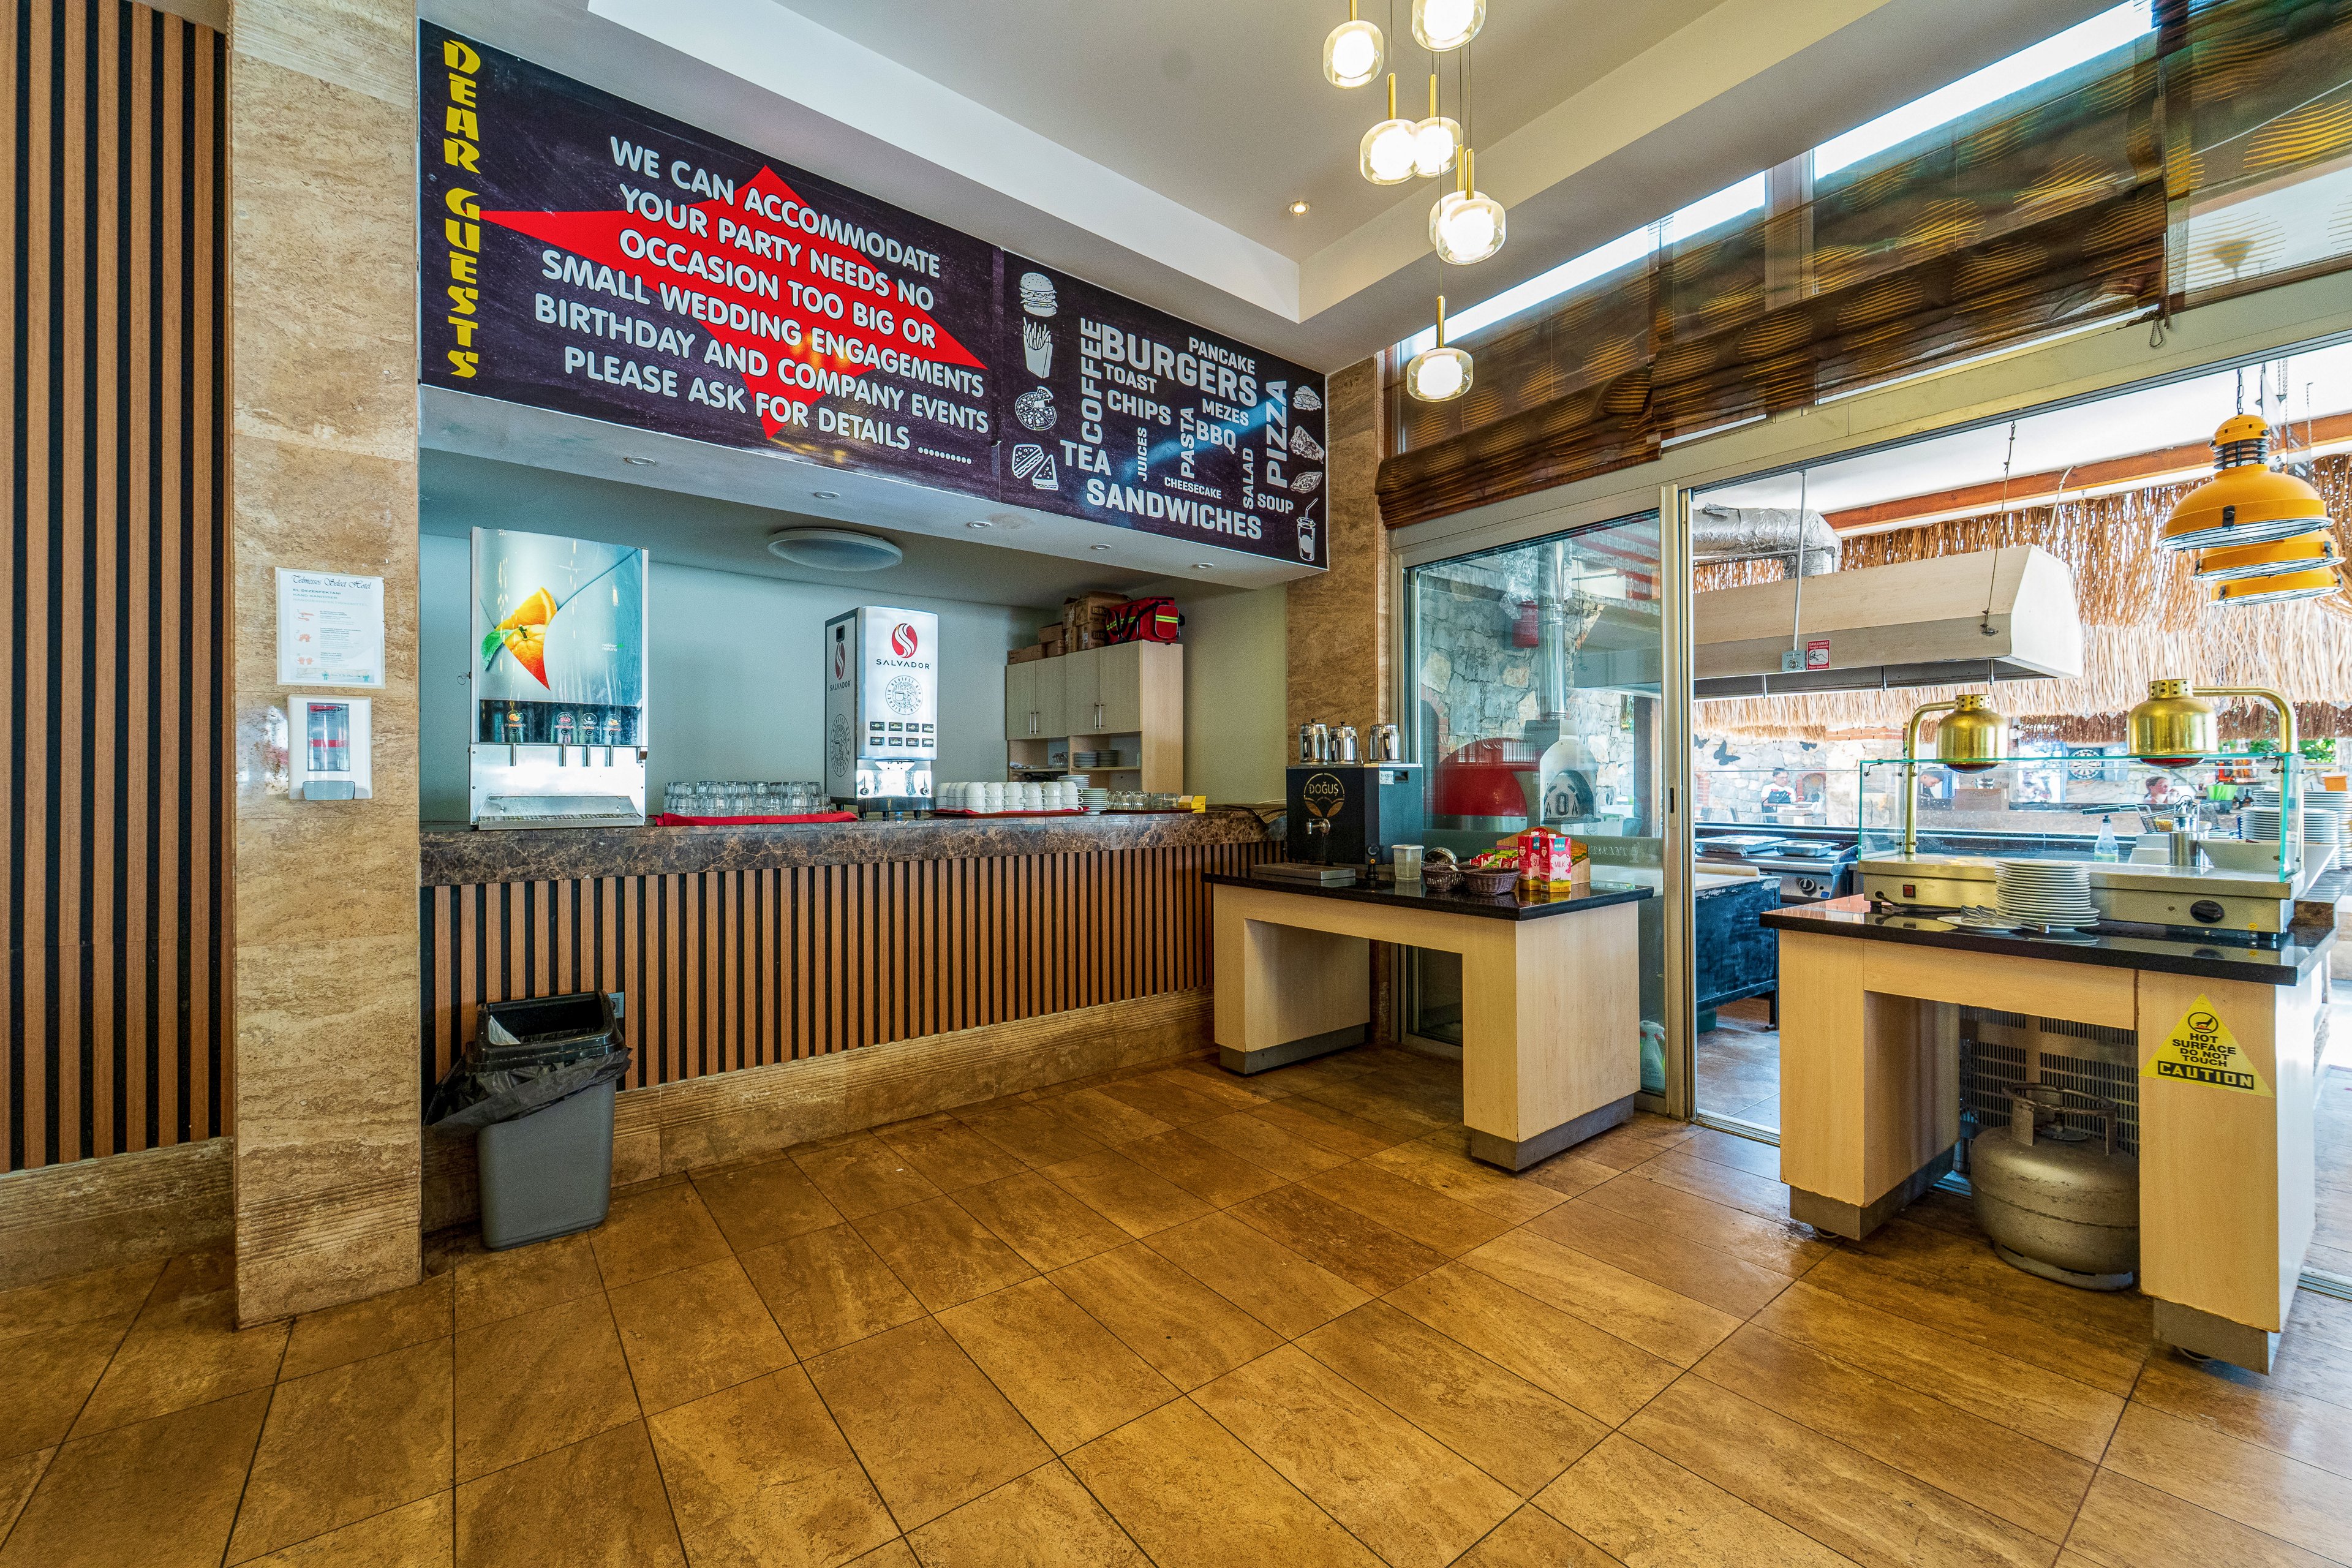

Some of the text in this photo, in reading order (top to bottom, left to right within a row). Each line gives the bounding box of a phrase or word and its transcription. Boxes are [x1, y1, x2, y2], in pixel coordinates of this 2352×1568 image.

[443, 39, 481, 379] DEAR GUESTS
[610, 136, 940, 277] WE CAN ACCOMMODATE
[620, 183, 934, 311] YOUR PARTY NEEDS NO
[619, 228, 936, 349] OCCASION TOO BIG OR
[541, 249, 984, 398] SMALL WEDDING ENGAGEMENTS
[535, 293, 989, 433] BIRTHDAY AND COMPANY EVENTS
[1102, 323, 1257, 407] BURGERS
[1188, 336, 1256, 375] PANCAKE
[565, 345, 678, 398] PLEASE
[688, 376, 747, 414] ASK
[755, 392, 809, 428] FOR
[818, 407, 910, 450] DETAILS
[1080, 317, 1102, 445] COFFEE
[1102, 363, 1157, 394] TOAST
[1107, 389, 1171, 425] CHIPS
[1202, 398, 1250, 426] MEZES
[1180, 407, 1194, 479] PASTA
[1196, 423, 1236, 455] BBQ
[1266, 380, 1287, 489] PIZZA
[1060, 439, 1112, 477] TEA
[1137, 427, 1148, 482] JUICES
[1164, 477, 1221, 499] CHEESECAKE
[1243, 448, 1254, 510] SALAD
[1087, 478, 1262, 540] SANDWICHES
[1257, 492, 1294, 514] SOUP
[324, 578, 347, 587] Select
[349, 580, 372, 589] Hotel
[876, 659, 930, 669] SALVADOR
[829, 680, 851, 692] SALVADOR
[1309, 782, 1339, 796] DOĞUŞ
[2172, 1039, 2236, 1055] SURFACE
[2180, 1047, 2230, 1060] DO NOT
[2190, 1033, 2218, 1044] HOT
[2159, 1062, 2252, 1088] CAUTION
[2182, 1055, 2227, 1067] TOUCH
